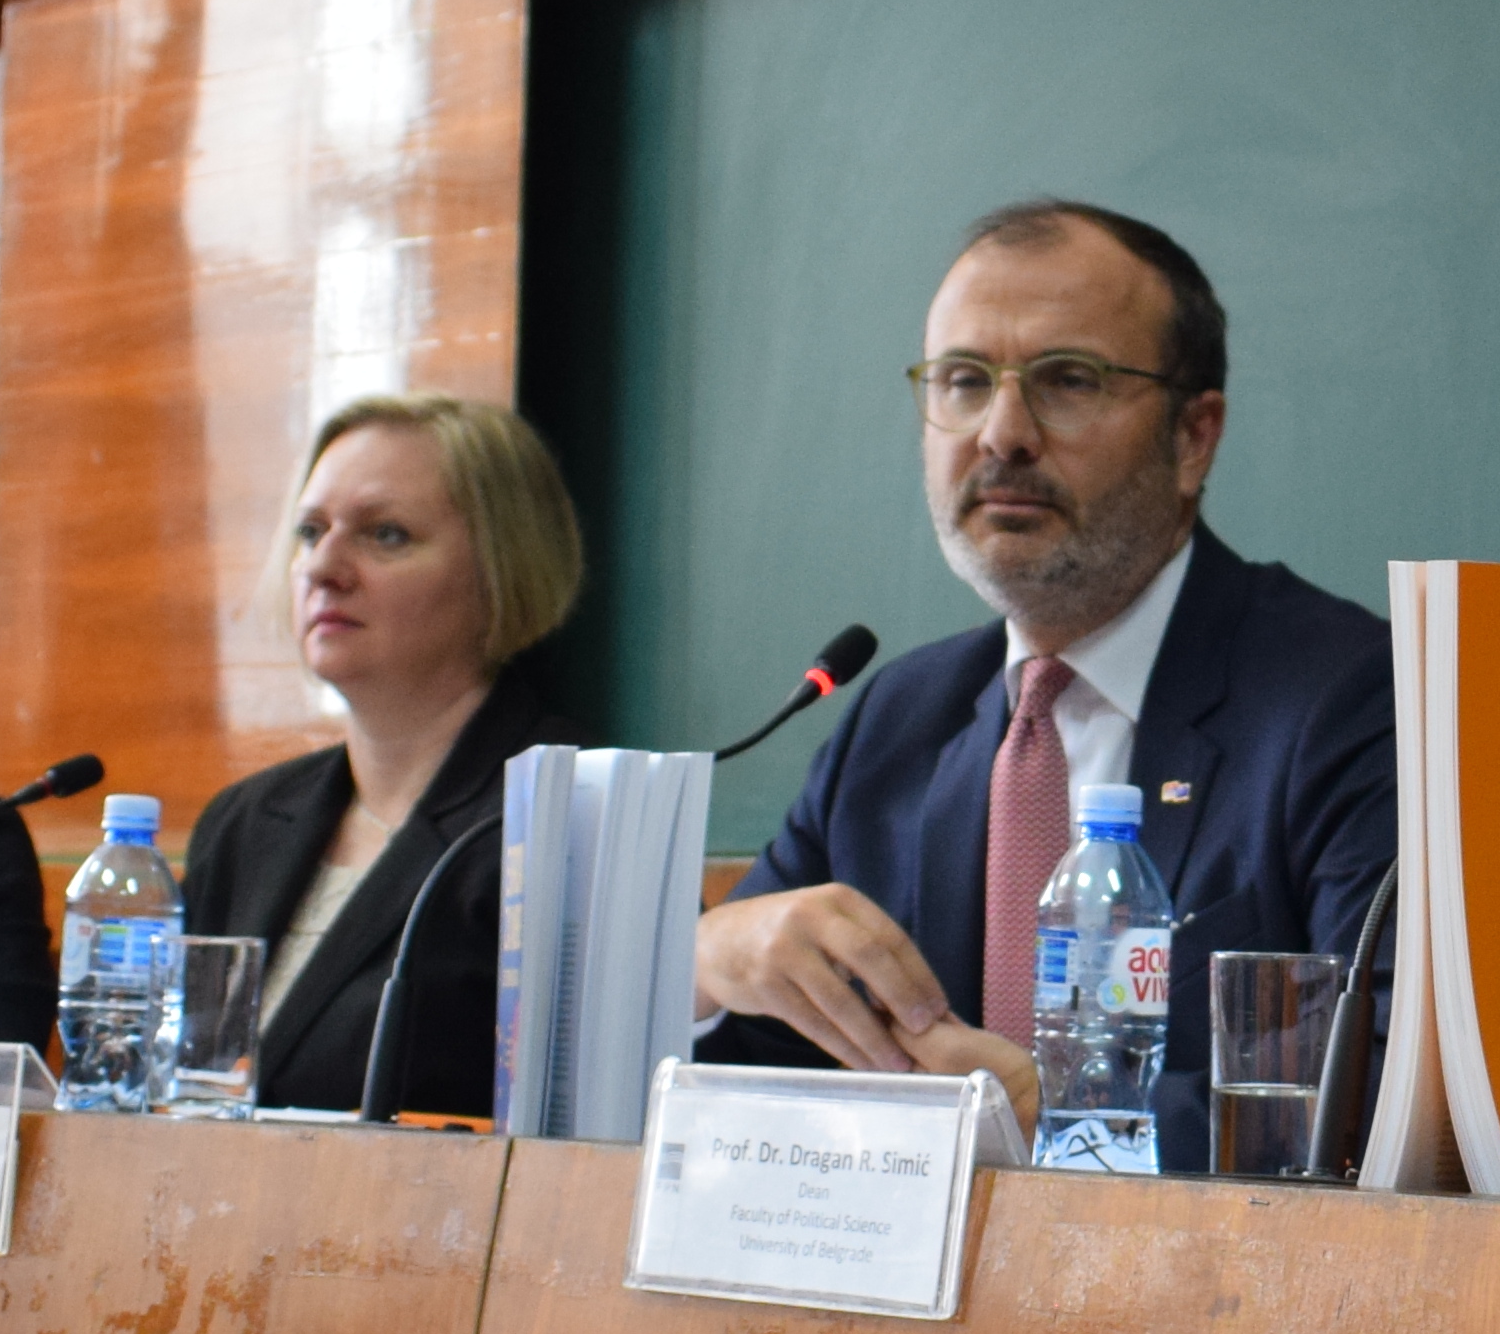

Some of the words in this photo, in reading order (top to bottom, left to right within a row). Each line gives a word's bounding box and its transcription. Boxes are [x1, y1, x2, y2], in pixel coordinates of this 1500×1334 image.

[712, 1138, 751, 1162] Prof.
[758, 1142, 783, 1165] Dr.
[789, 1144, 853, 1173] Dragan
[859, 1150, 875, 1172] R.
[881, 1151, 931, 1177] Simić
[798, 1182, 830, 1200] Dean
[730, 1204, 774, 1227] Faculty
[777, 1209, 792, 1225] of
[792, 1210, 841, 1230] Political
[843, 1215, 891, 1236] Science
[739, 1235, 800, 1258] University
[802, 1240, 818, 1257] of
[818, 1242, 873, 1264] Belgrade
